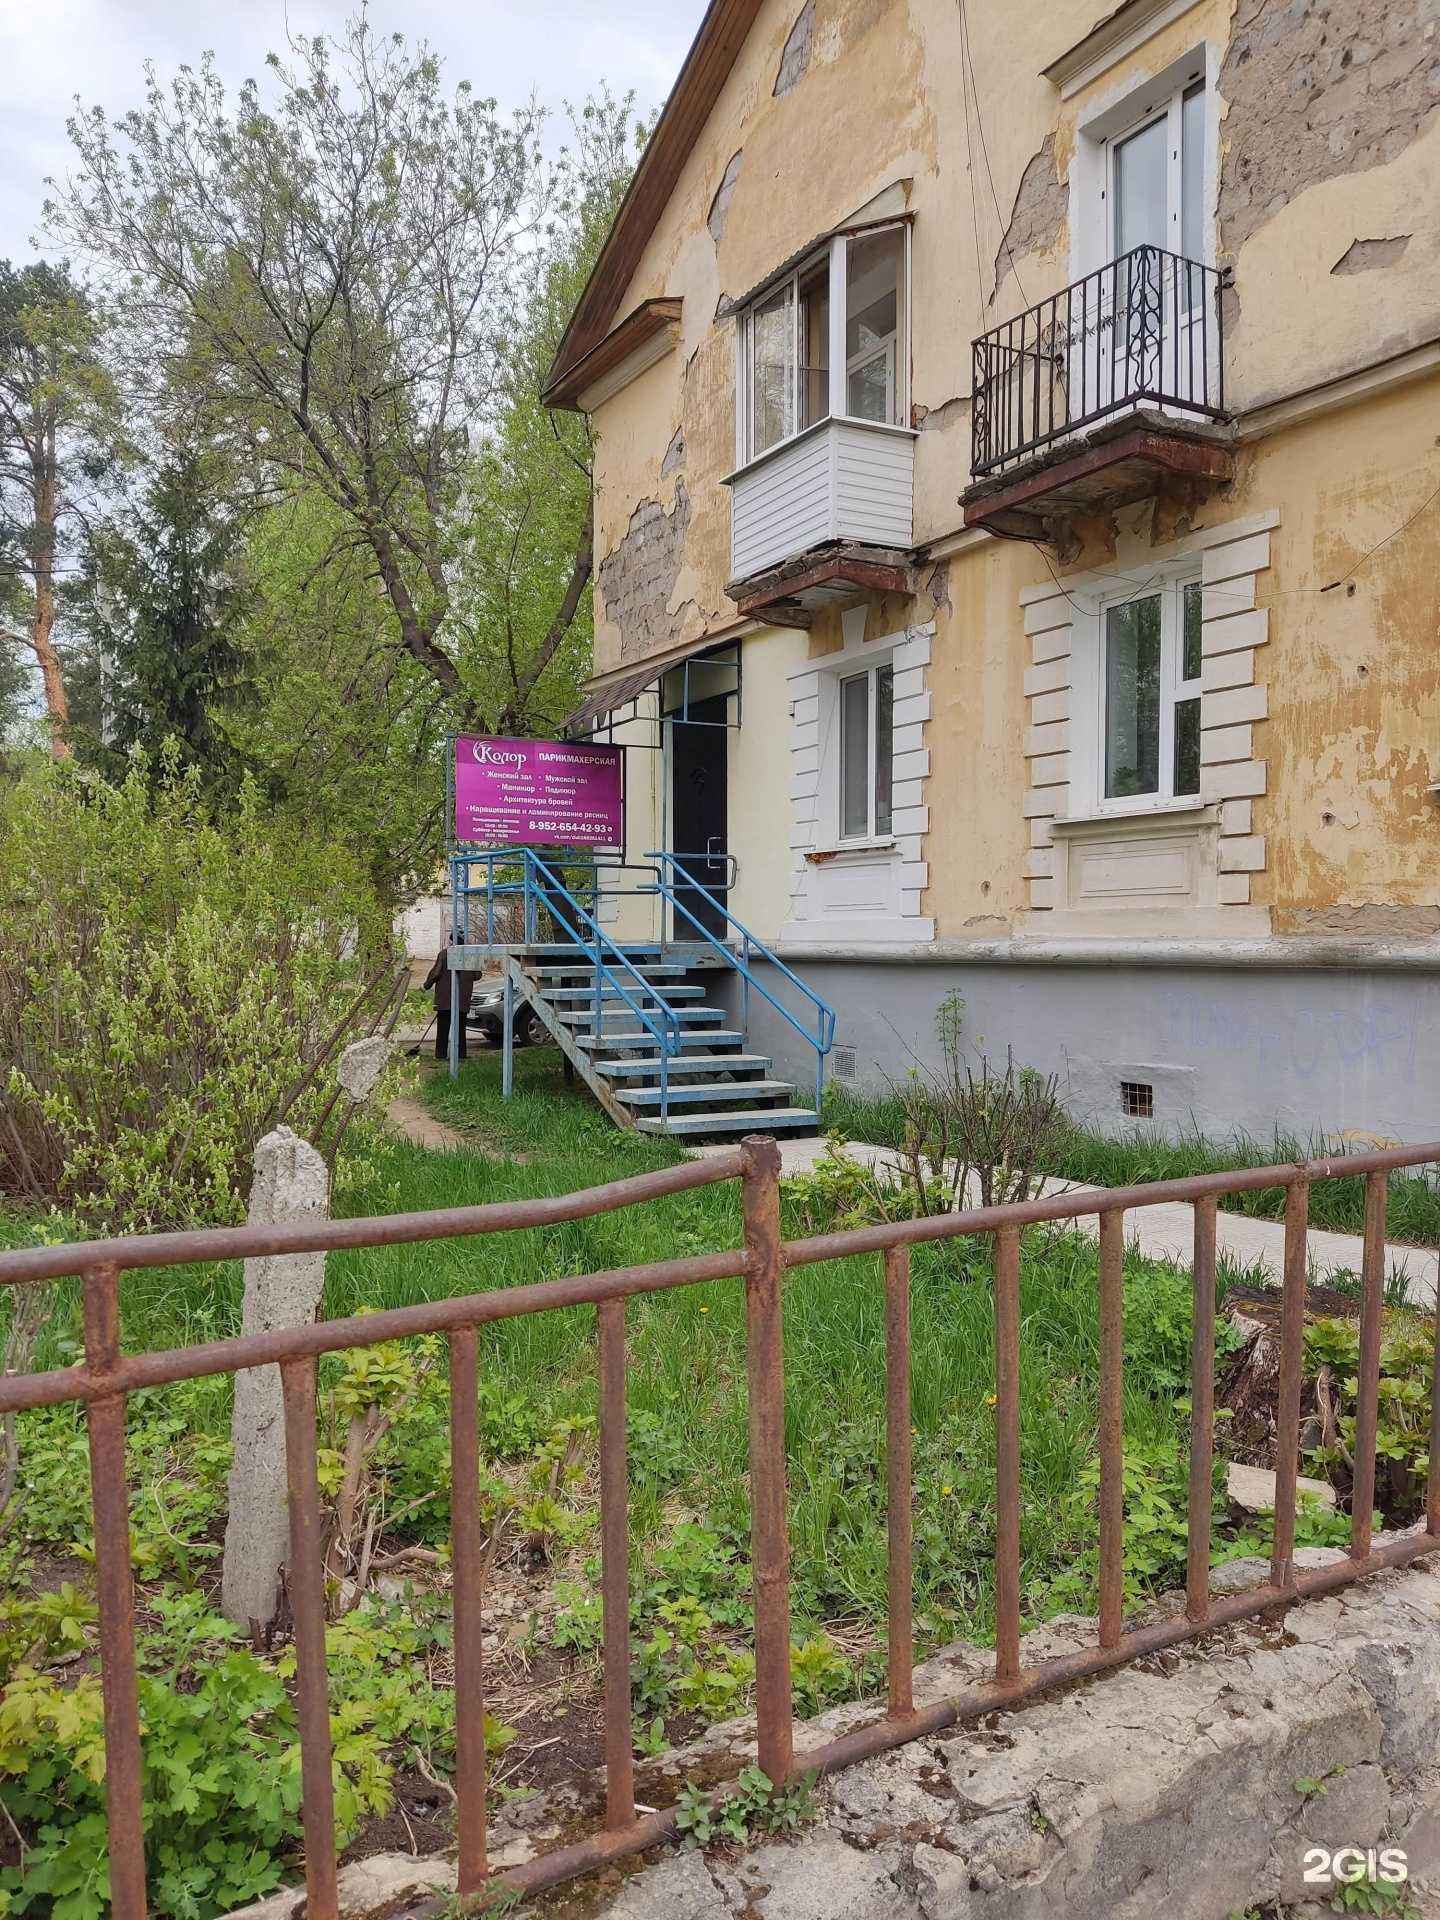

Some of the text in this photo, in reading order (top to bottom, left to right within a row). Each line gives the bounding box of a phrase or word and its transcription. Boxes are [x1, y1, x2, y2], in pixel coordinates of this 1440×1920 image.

[474, 742, 527, 770] Колор
[539, 752, 616, 766] ПАРИКМАХЕРСКАЯ
[487, 770, 519, 780] Женский
[520, 773, 532, 781] зал
[545, 774, 575, 784] Мужской
[501, 783, 576, 795] Маникюр Педикюр
[503, 795, 573, 807] Архитектура бровей
[469, 805, 521, 815] Наращивание
[528, 809, 583, 818] ламинирование
[584, 811, 609, 820] ресниц
[528, 821, 607, 833] 8-952-654-42-93
